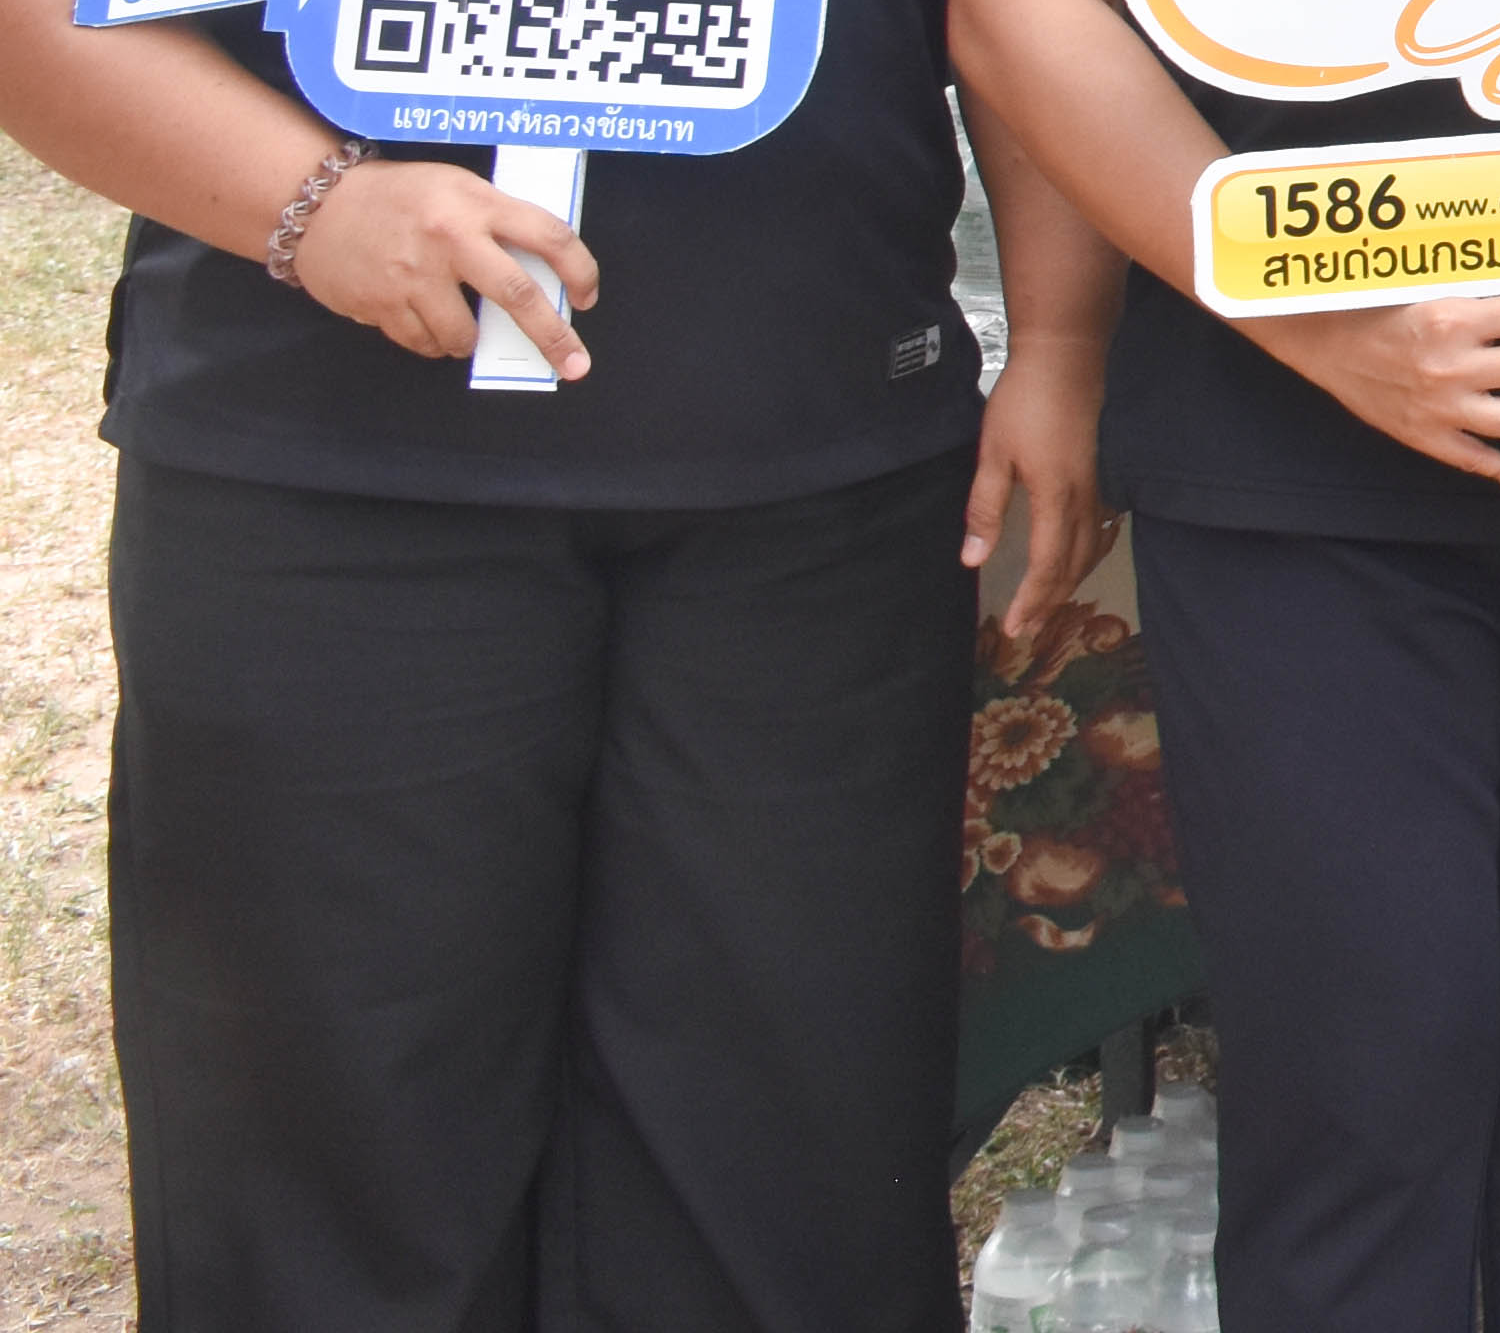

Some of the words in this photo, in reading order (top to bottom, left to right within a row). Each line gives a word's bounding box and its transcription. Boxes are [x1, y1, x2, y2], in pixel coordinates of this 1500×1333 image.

[393, 101, 695, 144] แขวงทางหลวงชัยนาท
[1254, 175, 1405, 240] 1586
